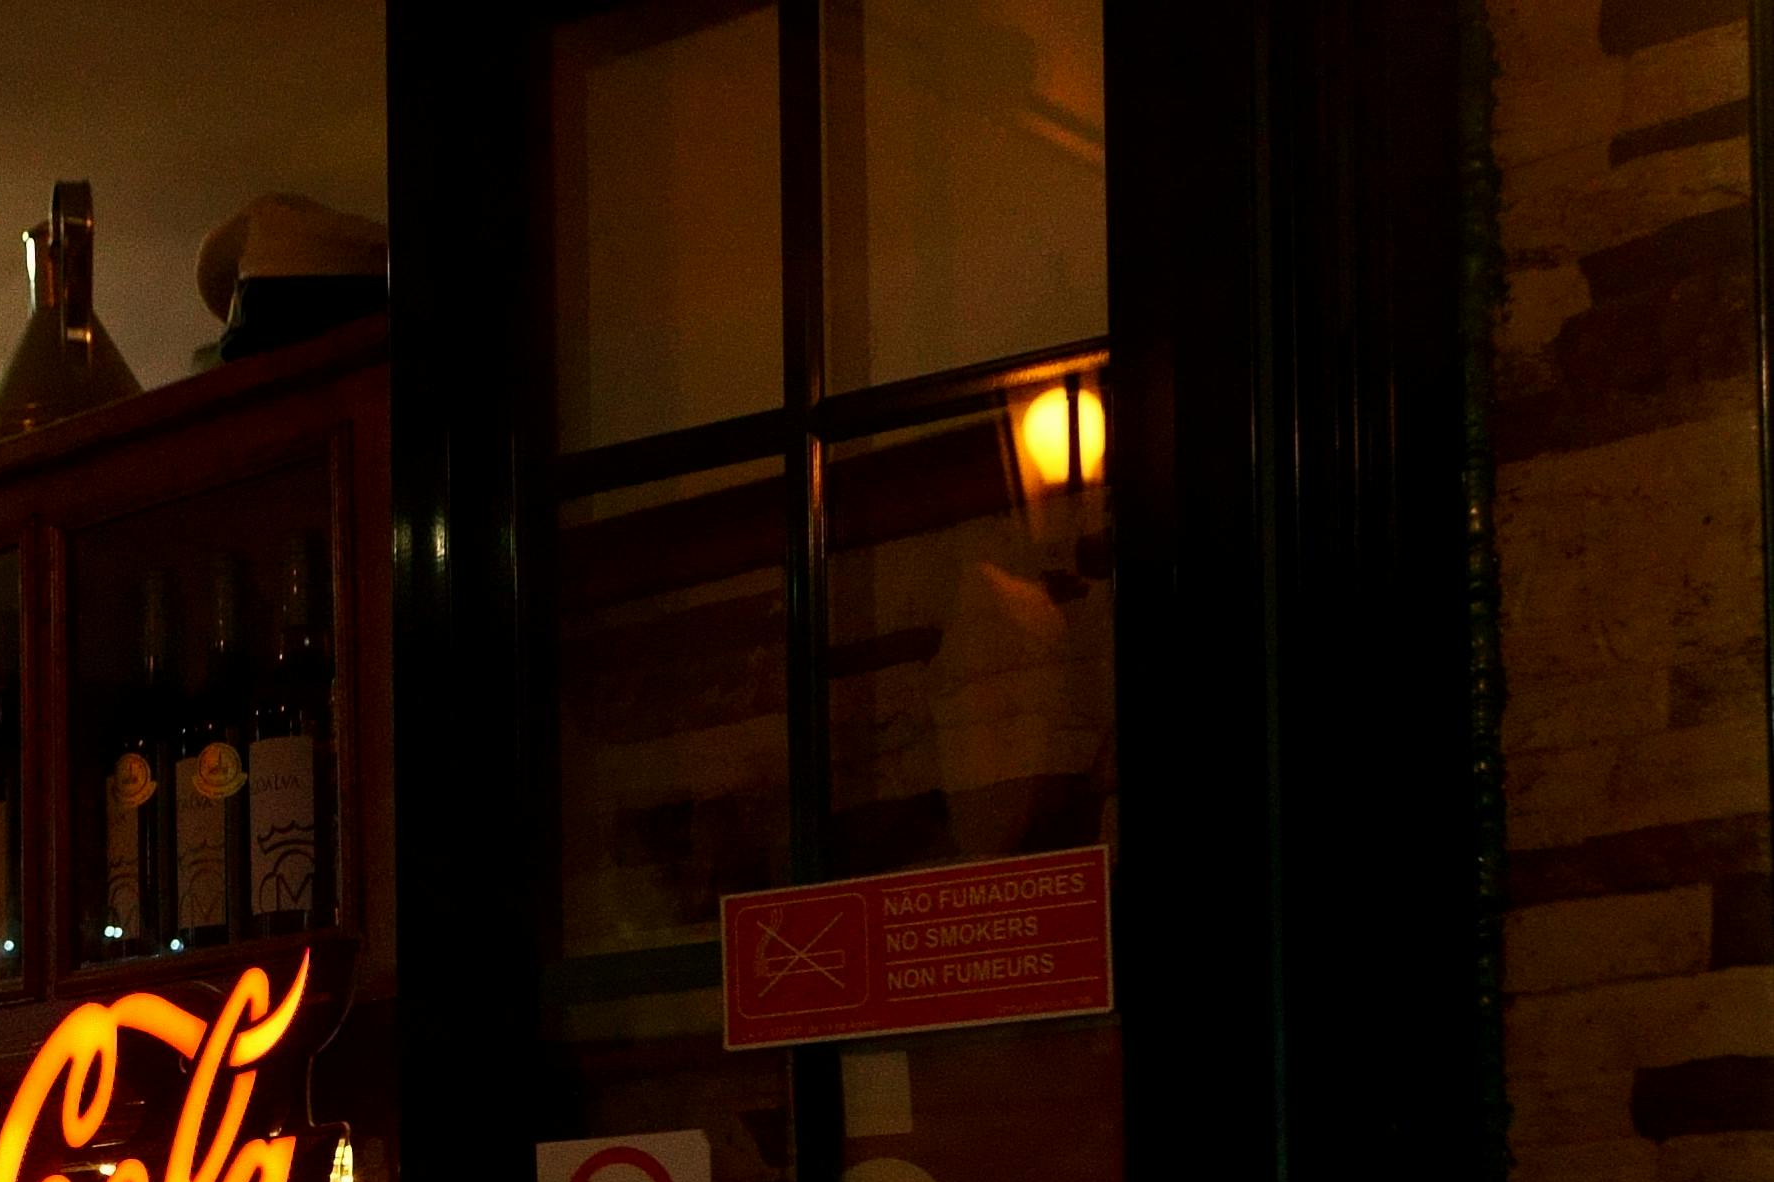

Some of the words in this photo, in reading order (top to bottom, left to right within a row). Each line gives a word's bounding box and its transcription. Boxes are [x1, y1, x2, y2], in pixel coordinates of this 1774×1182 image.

[882, 889, 932, 917] NÃO
[939, 872, 1086, 912] FUMADORES
[886, 930, 919, 953] NO
[926, 915, 1039, 948] SMOKERS
[887, 966, 935, 992] NON
[943, 953, 1055, 985] FUMEURS
